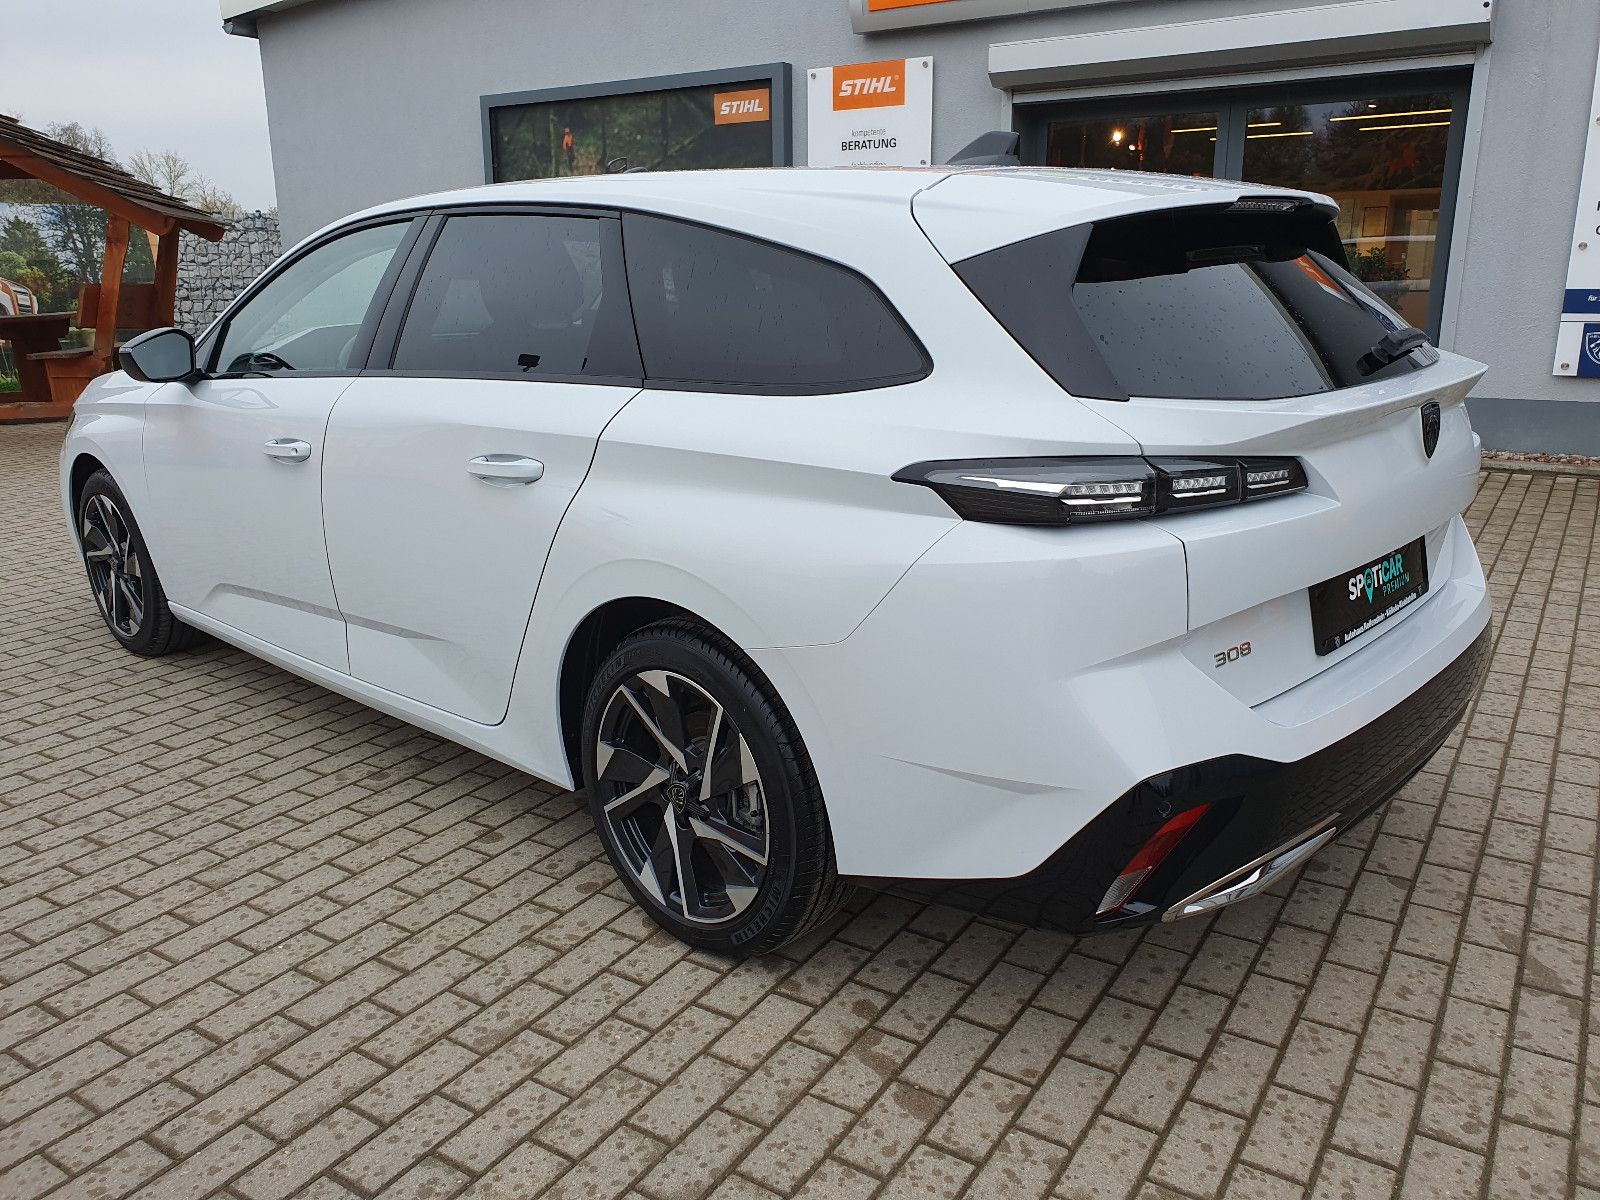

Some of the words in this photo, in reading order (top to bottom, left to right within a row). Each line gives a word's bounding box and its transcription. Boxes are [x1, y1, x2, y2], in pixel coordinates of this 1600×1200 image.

[720, 98, 764, 116] STIHL
[841, 137, 897, 152] BERATUNG
[1382, 572, 1410, 597] PREMIUM
[1214, 641, 1252, 668] 308
